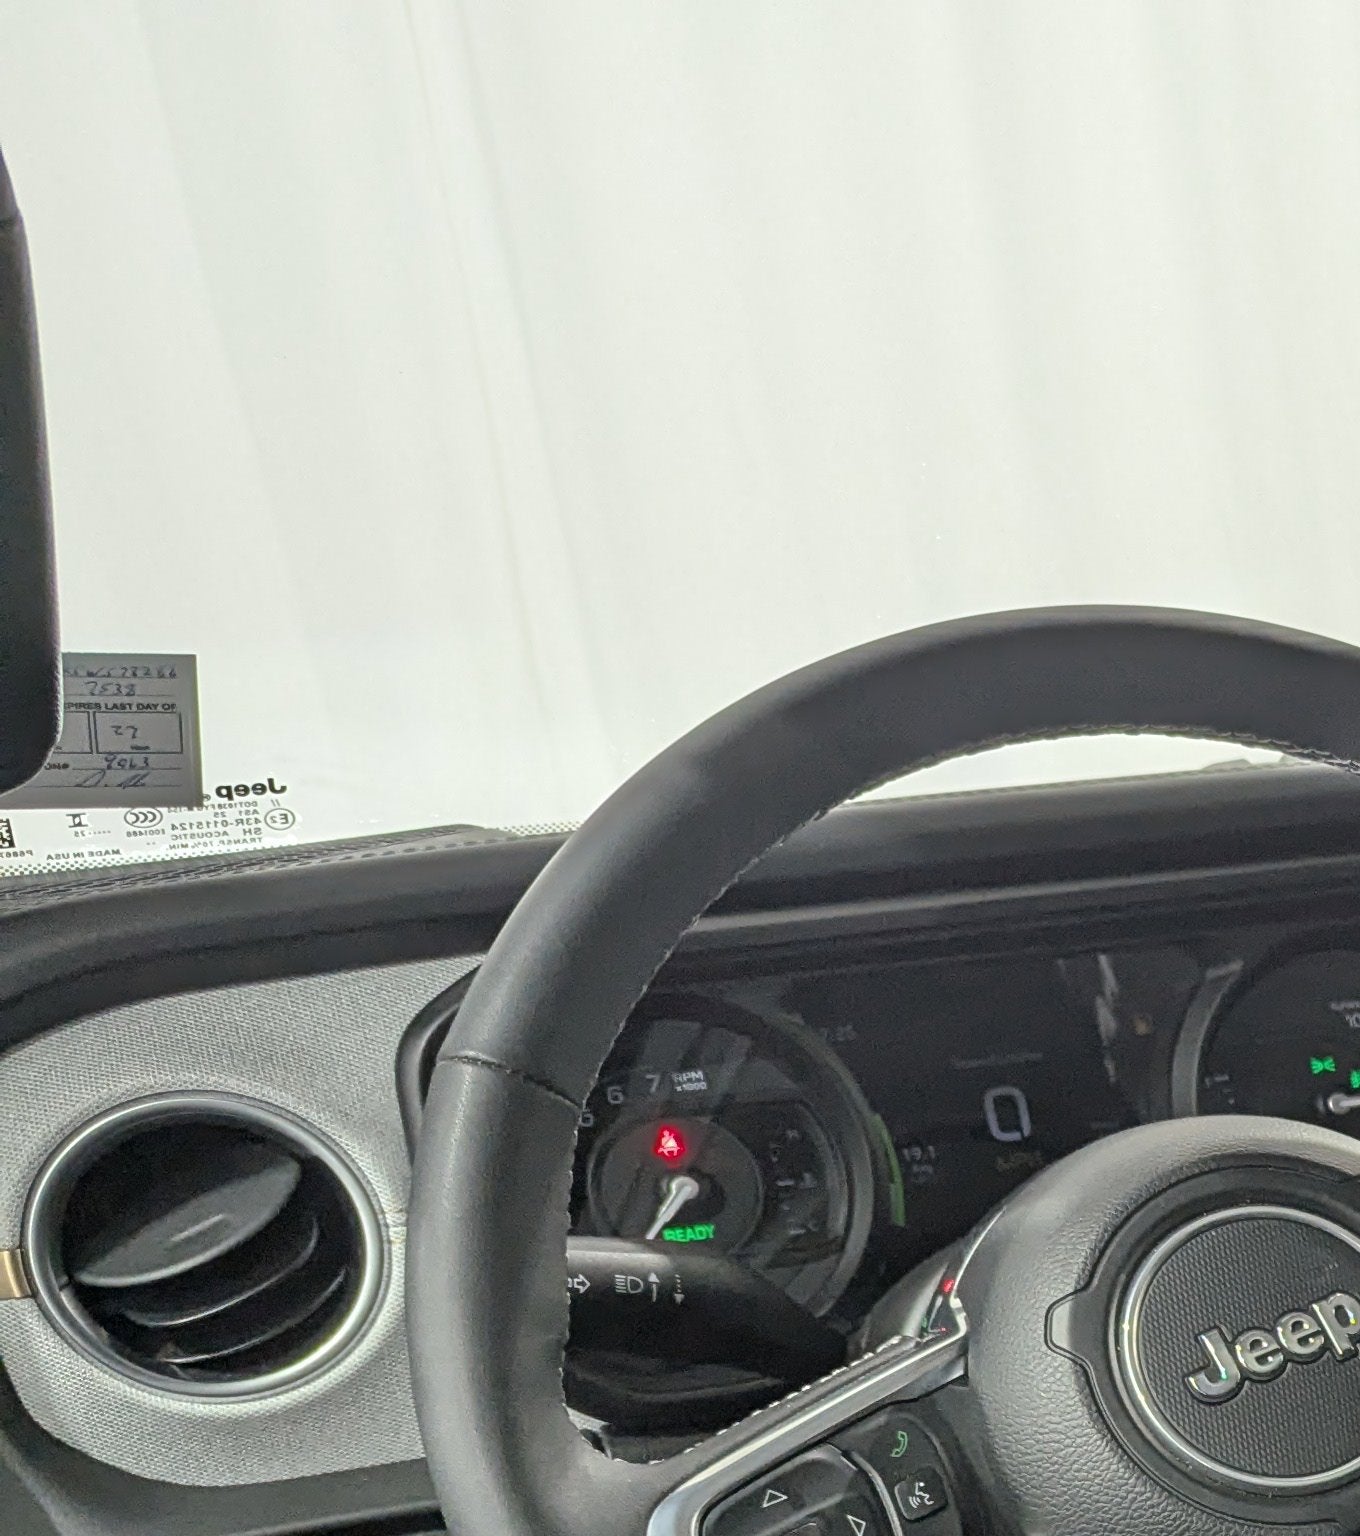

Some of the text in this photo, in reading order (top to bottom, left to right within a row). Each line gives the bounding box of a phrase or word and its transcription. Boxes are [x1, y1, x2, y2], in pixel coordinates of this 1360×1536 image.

[105, 703, 133, 711] LAST
[137, 703, 159, 711] DAY
[162, 703, 177, 711] OF
[645, 1070, 704, 1093] 7 RPM
[607, 1086, 624, 1104] 6
[983, 1086, 1032, 1142] 0
[663, 1224, 715, 1242] READY
